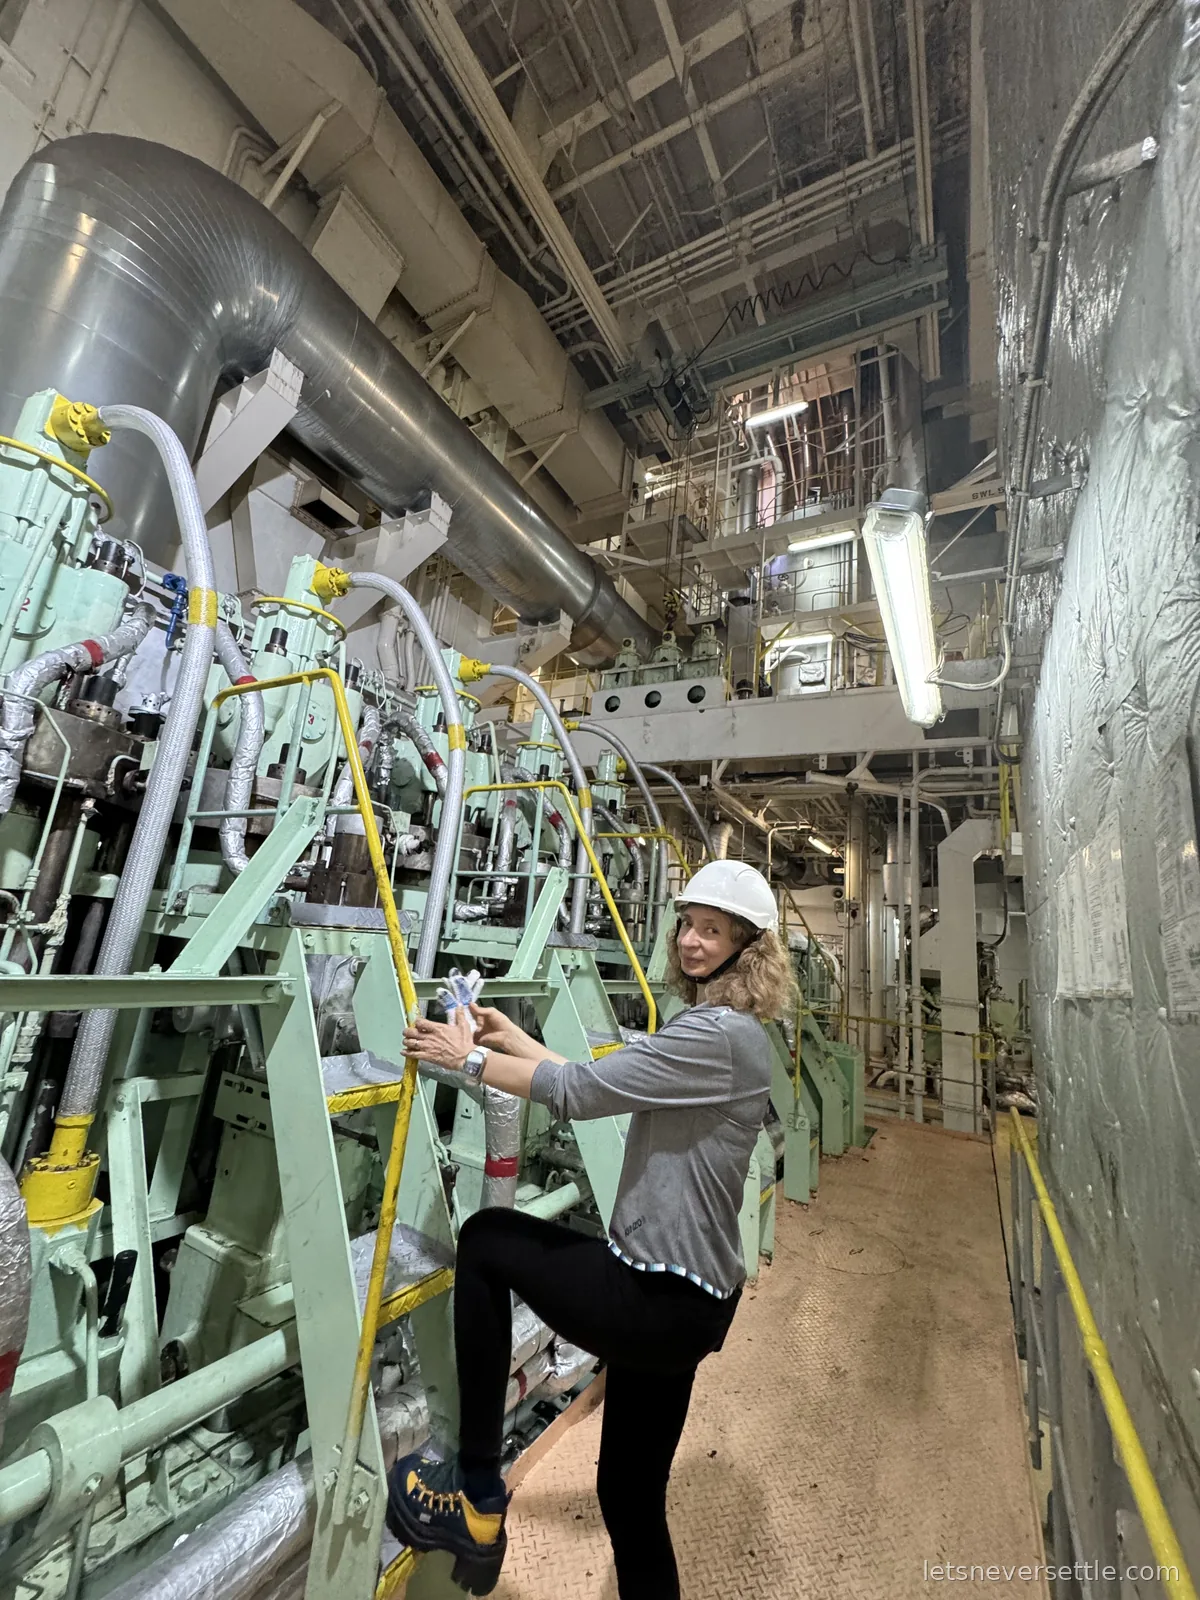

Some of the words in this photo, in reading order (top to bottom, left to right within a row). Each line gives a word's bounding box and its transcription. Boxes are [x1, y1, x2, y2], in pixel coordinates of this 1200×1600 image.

[972, 489, 995, 500] SWL
[20, 597, 31, 612] 2
[307, 713, 315, 726] 3
